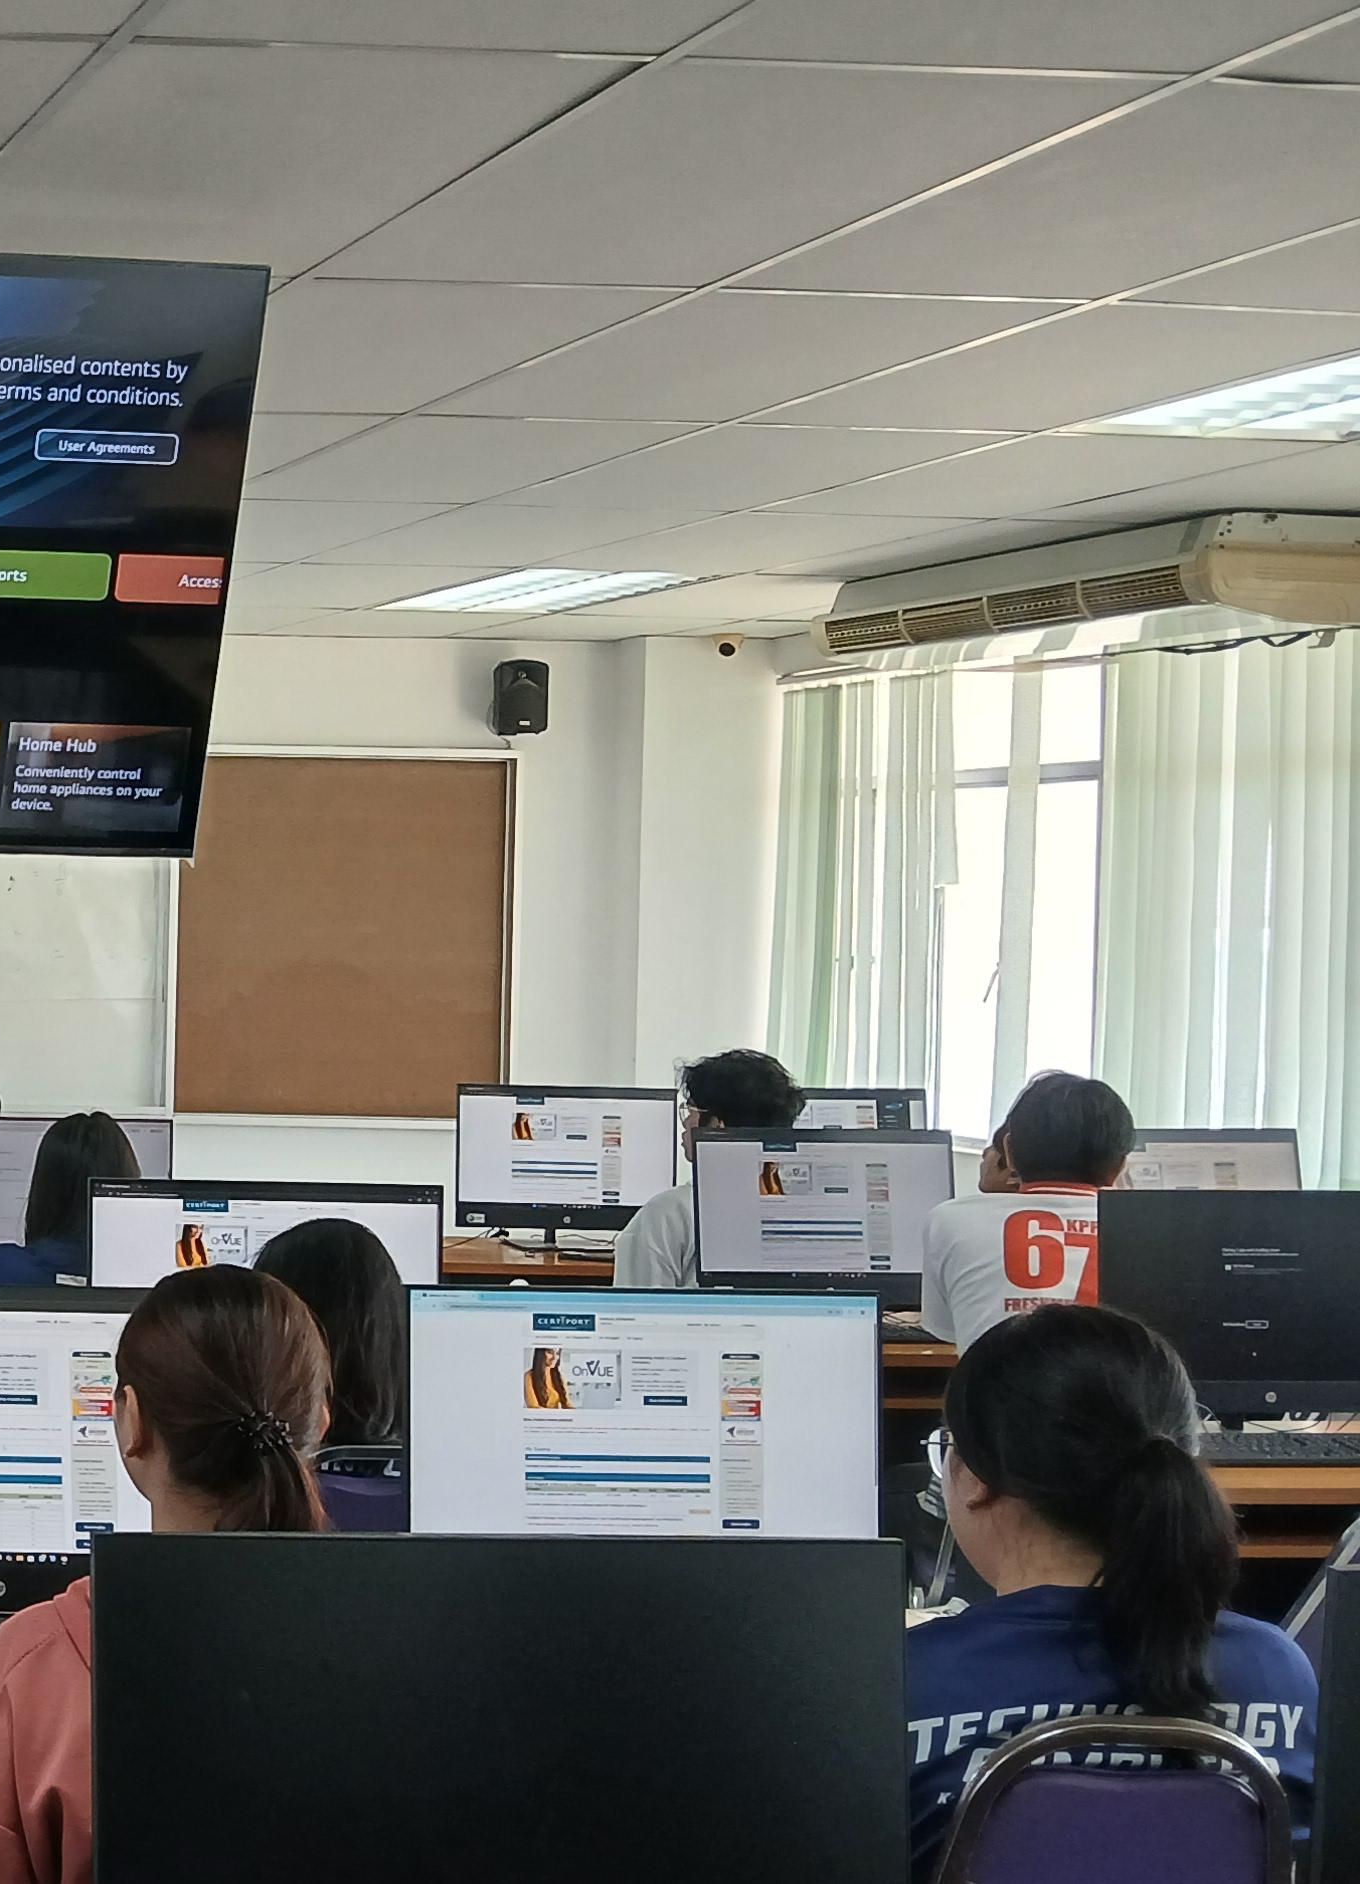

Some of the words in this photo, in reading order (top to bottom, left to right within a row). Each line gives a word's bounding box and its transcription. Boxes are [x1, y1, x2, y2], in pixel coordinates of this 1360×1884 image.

[79, 358, 160, 378] contents
[166, 361, 189, 384] by
[47, 384, 81, 402] and
[87, 386, 184, 407] conditions.
[59, 440, 85, 452] User
[87, 442, 156, 456] Agreements
[19, 737, 62, 752] Home
[66, 738, 96, 753] Hub
[14, 764, 94, 782] Conveniently
[97, 768, 141, 780] control
[13, 781, 47, 795] home
[50, 783, 113, 798] appliances
[117, 786, 132, 797] on
[134, 788, 164, 801] your
[12, 798, 54, 811] device.
[1003, 1209, 1099, 1306] 67
[572, 1360, 619, 1377] OnVUE
